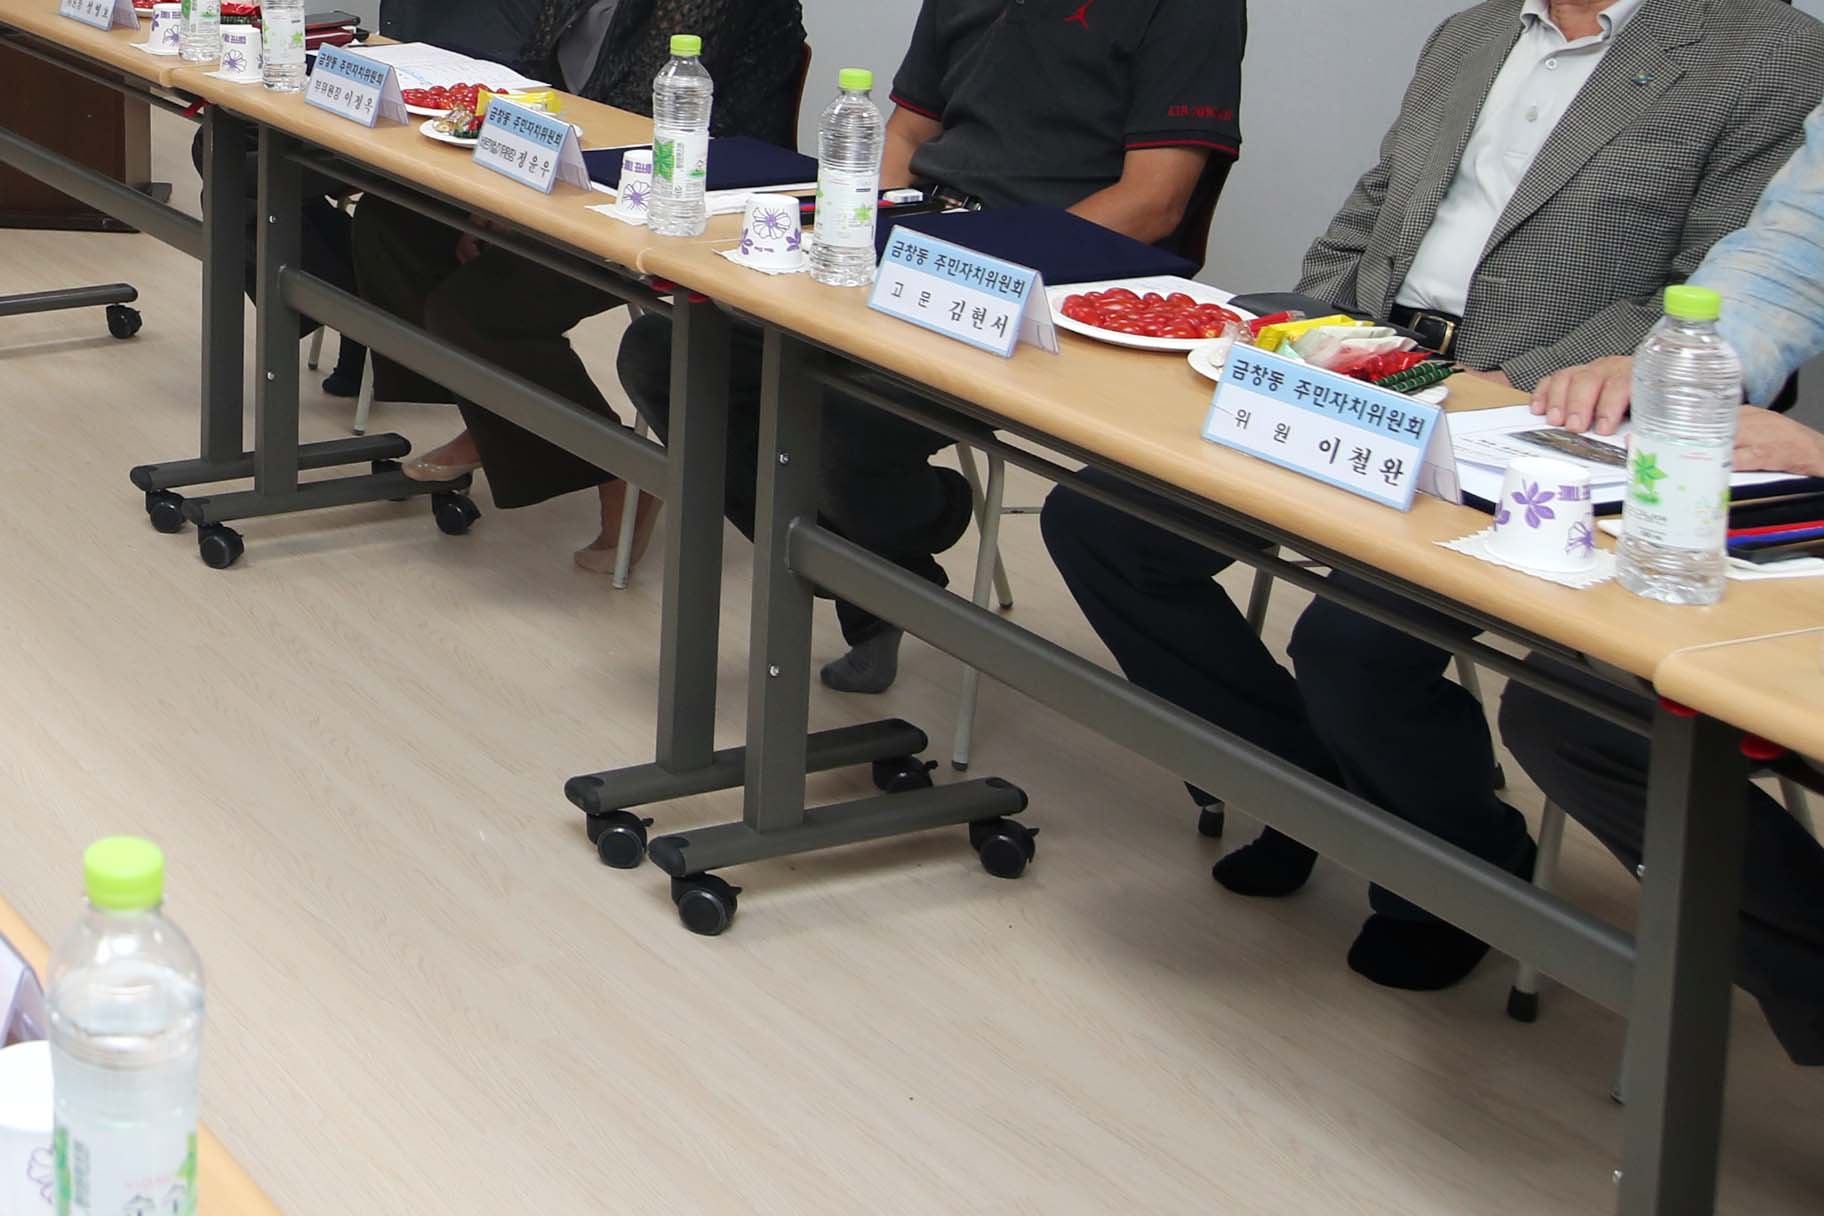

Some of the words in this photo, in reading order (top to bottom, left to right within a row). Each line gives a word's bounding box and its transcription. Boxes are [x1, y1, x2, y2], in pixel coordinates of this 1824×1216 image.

[489, 106, 512, 126] 금창동
[513, 116, 563, 146] 주민자치위원회
[891, 240, 929, 266] 금창동
[933, 254, 1026, 299] 주민자치위원회
[949, 299, 1009, 338] 김현서
[1232, 359, 1285, 392] 금창동
[1293, 379, 1425, 440] 주민자치위원회
[1319, 436, 1404, 486] 이철완
